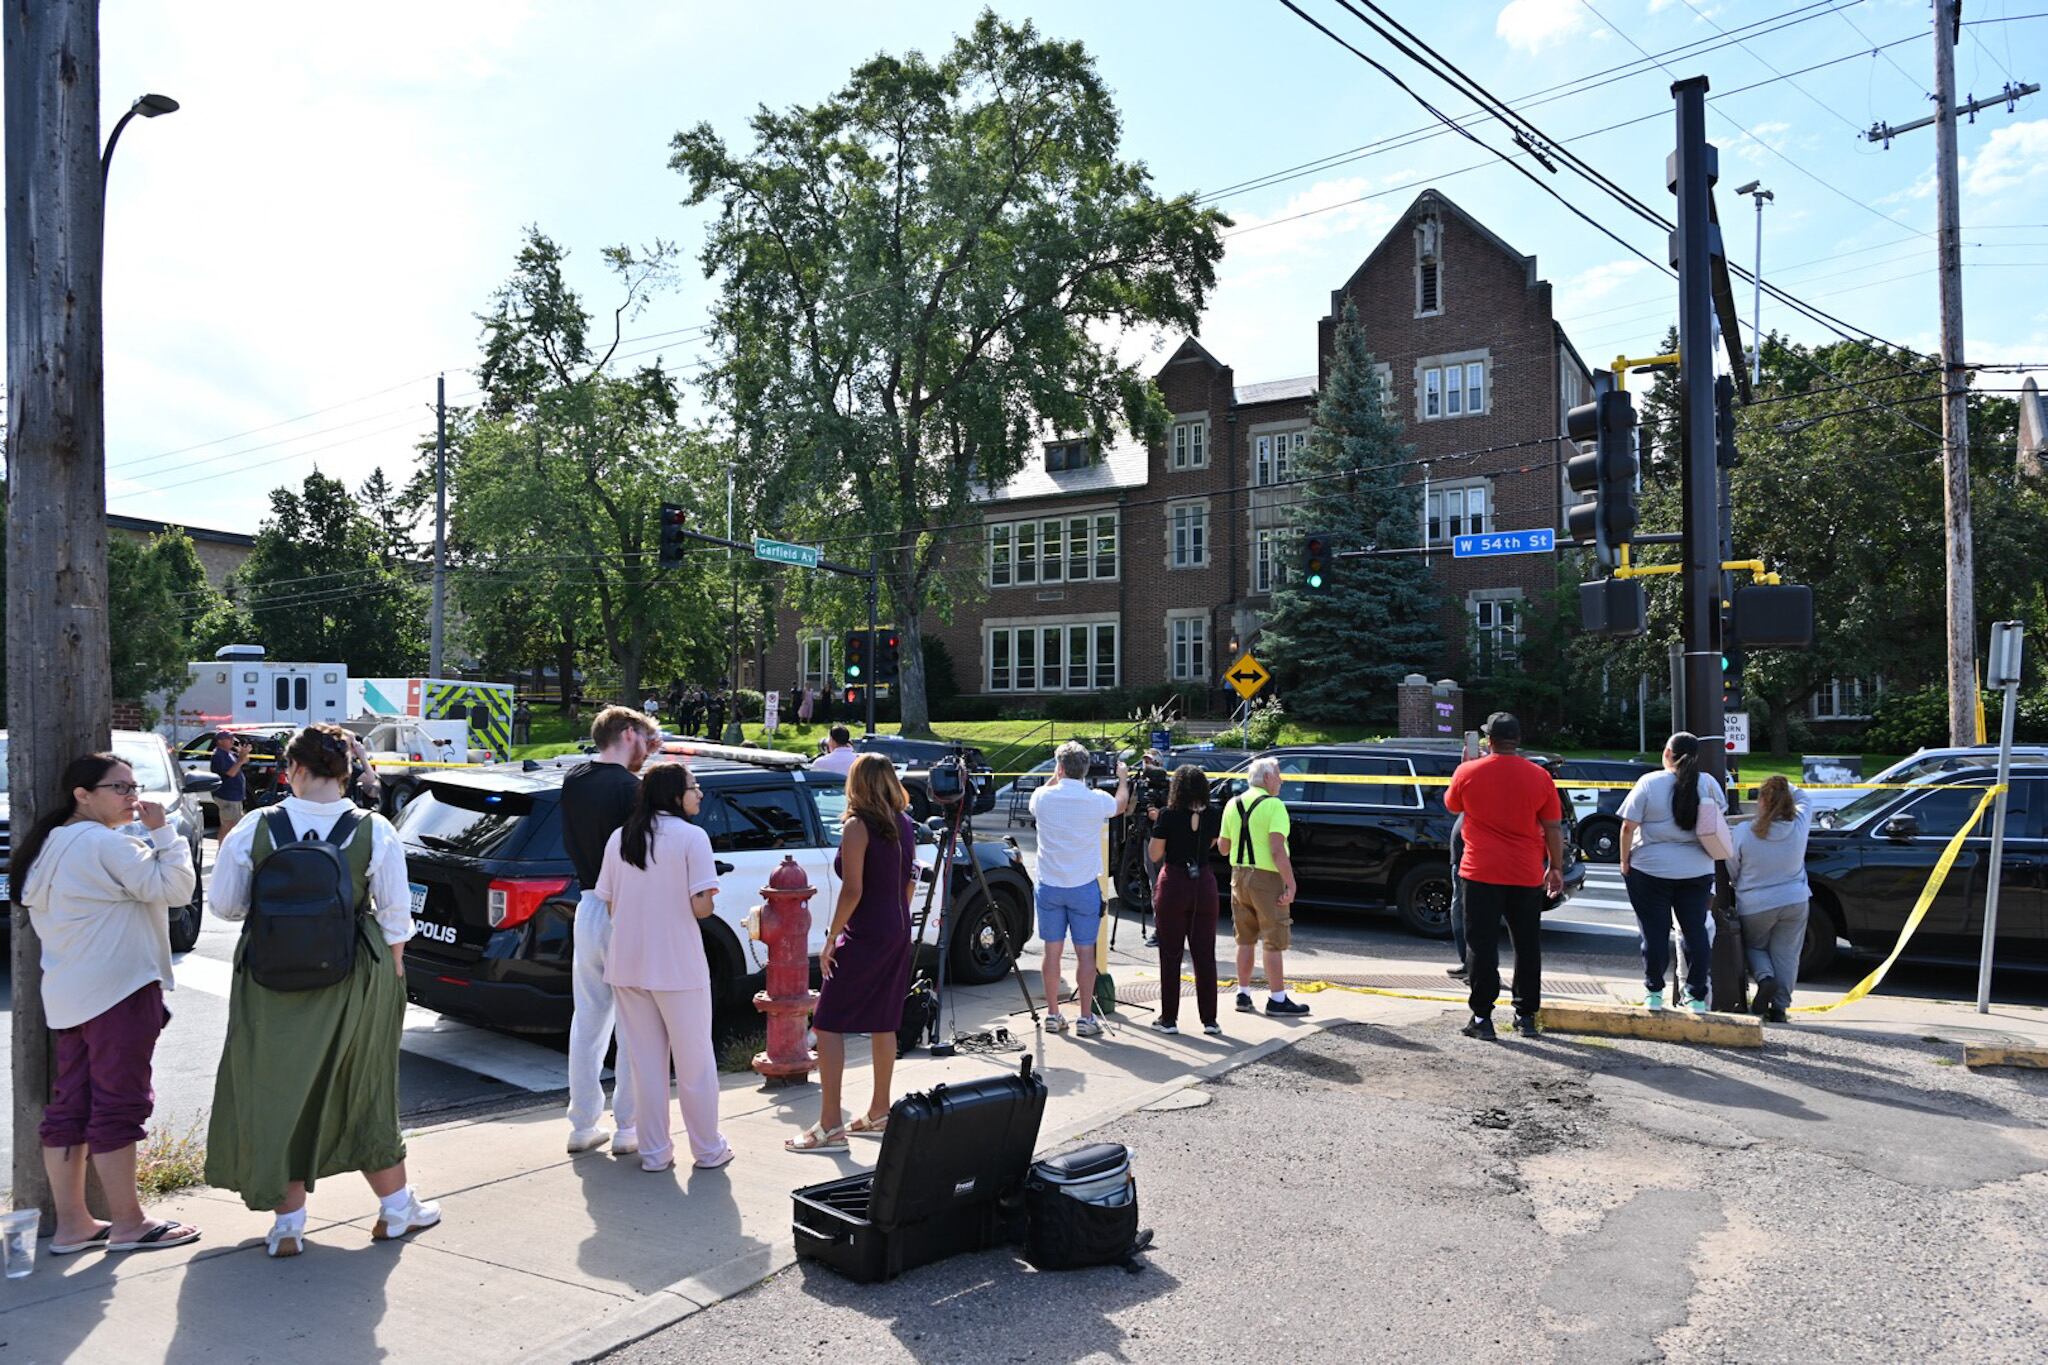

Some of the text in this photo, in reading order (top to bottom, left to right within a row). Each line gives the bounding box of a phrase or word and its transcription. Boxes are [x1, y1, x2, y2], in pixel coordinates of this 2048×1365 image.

[1461, 535, 1547, 552] W 54th St
[760, 544, 813, 562] Garfield Av
[1724, 716, 1738, 724] NO
[416, 920, 457, 944] POLIS
